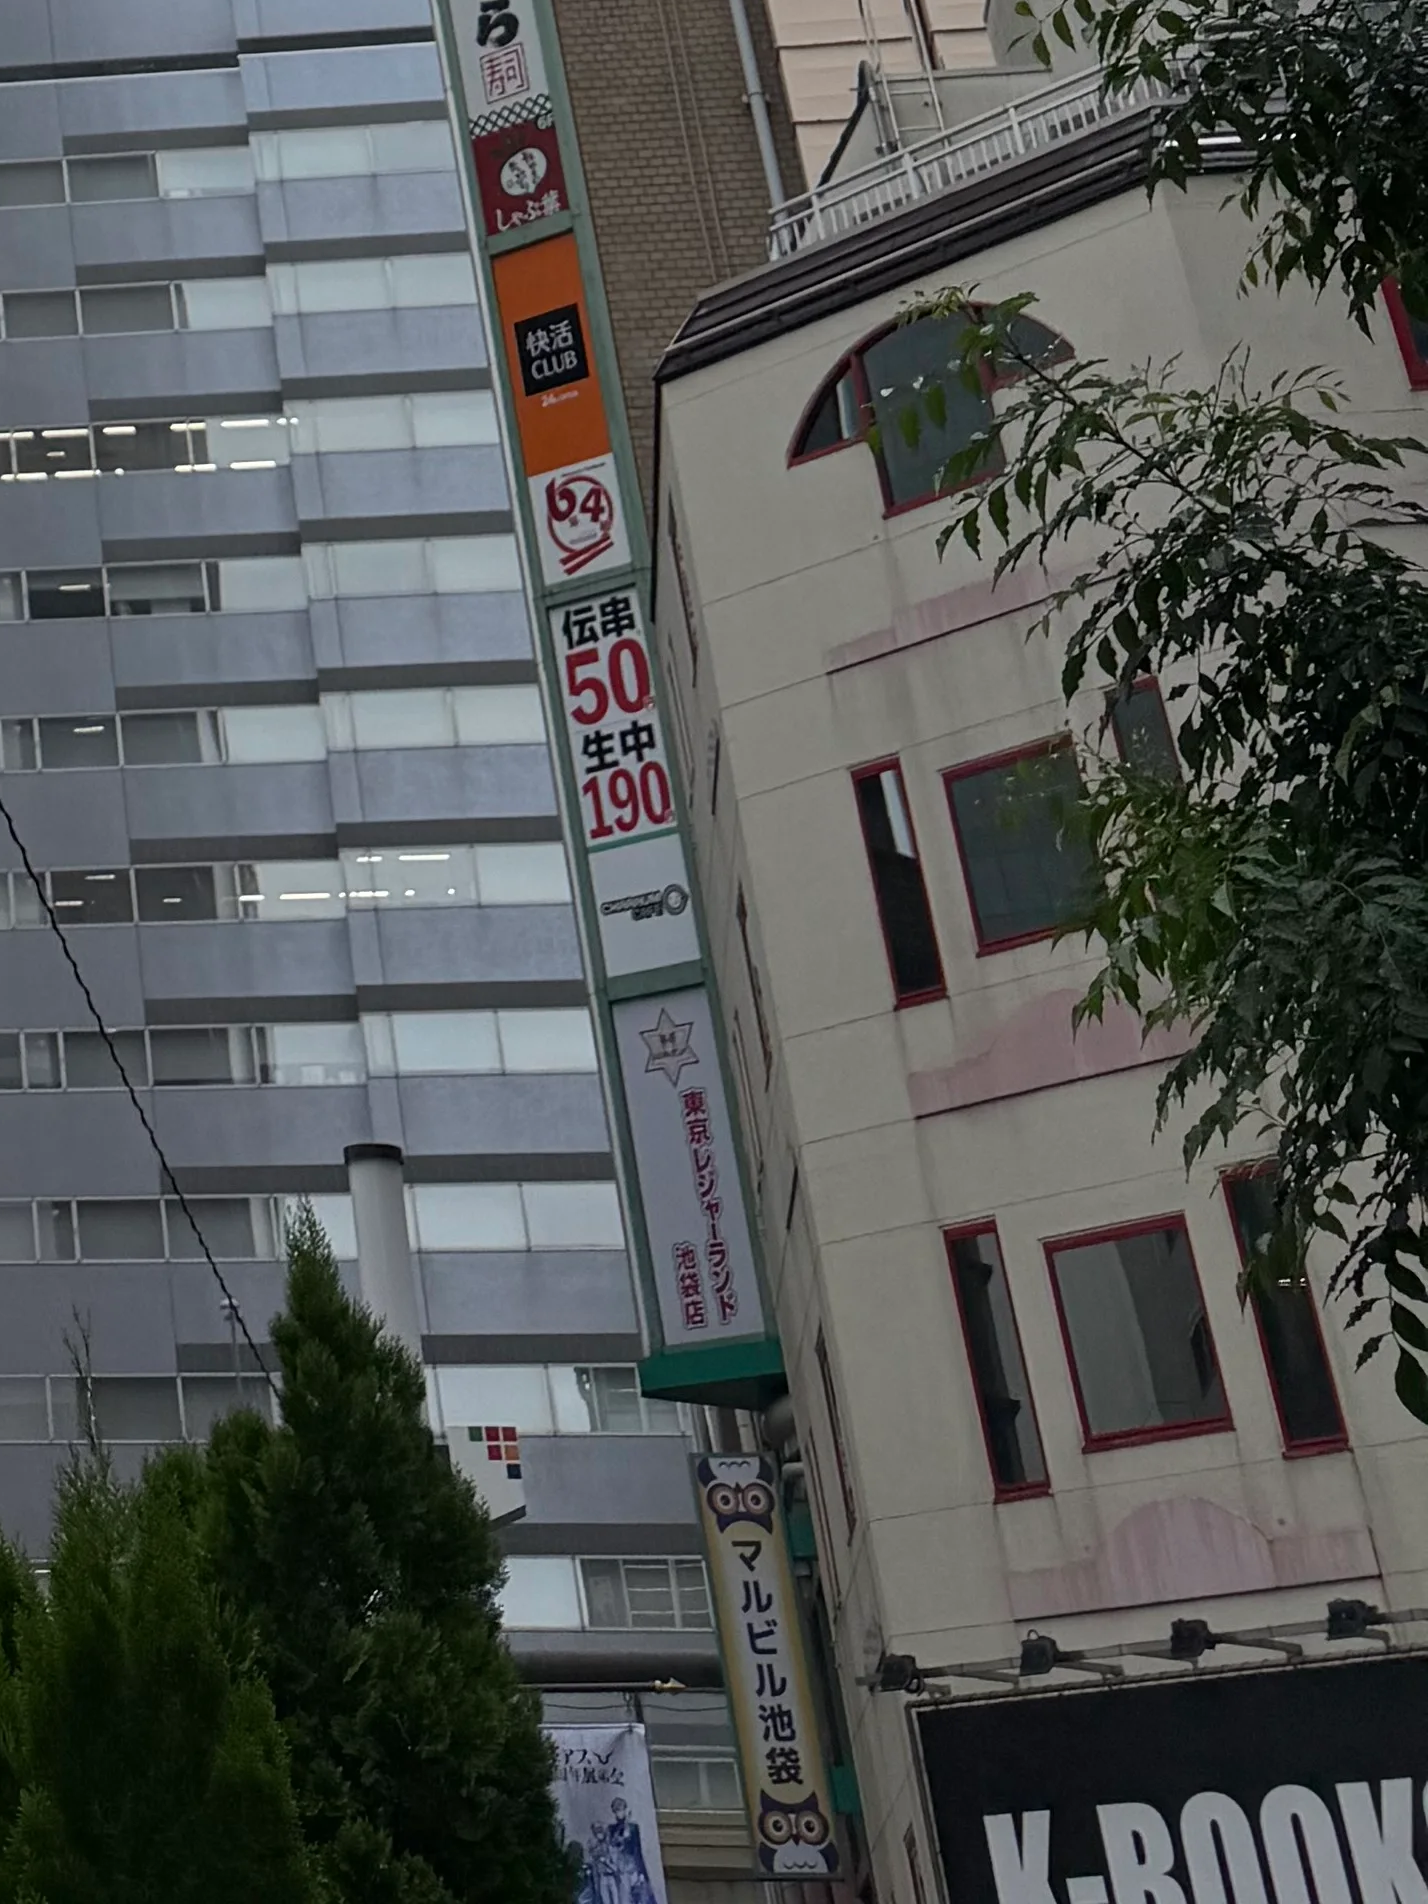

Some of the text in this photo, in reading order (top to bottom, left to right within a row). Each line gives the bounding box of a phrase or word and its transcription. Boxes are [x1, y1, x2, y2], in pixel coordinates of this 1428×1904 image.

[495, 189, 562, 232] しゃぶ葉
[525, 319, 574, 358] 快活
[531, 350, 578, 380] CLUB
[561, 594, 638, 650] 伝串
[580, 720, 658, 776] 生中
[679, 1087, 739, 1326] 東京レジャーランド
[673, 1242, 709, 1331] 池袋店
[730, 1539, 805, 1789] マルビル池袋
[982, 1776, 1428, 1904] K-BOOK
